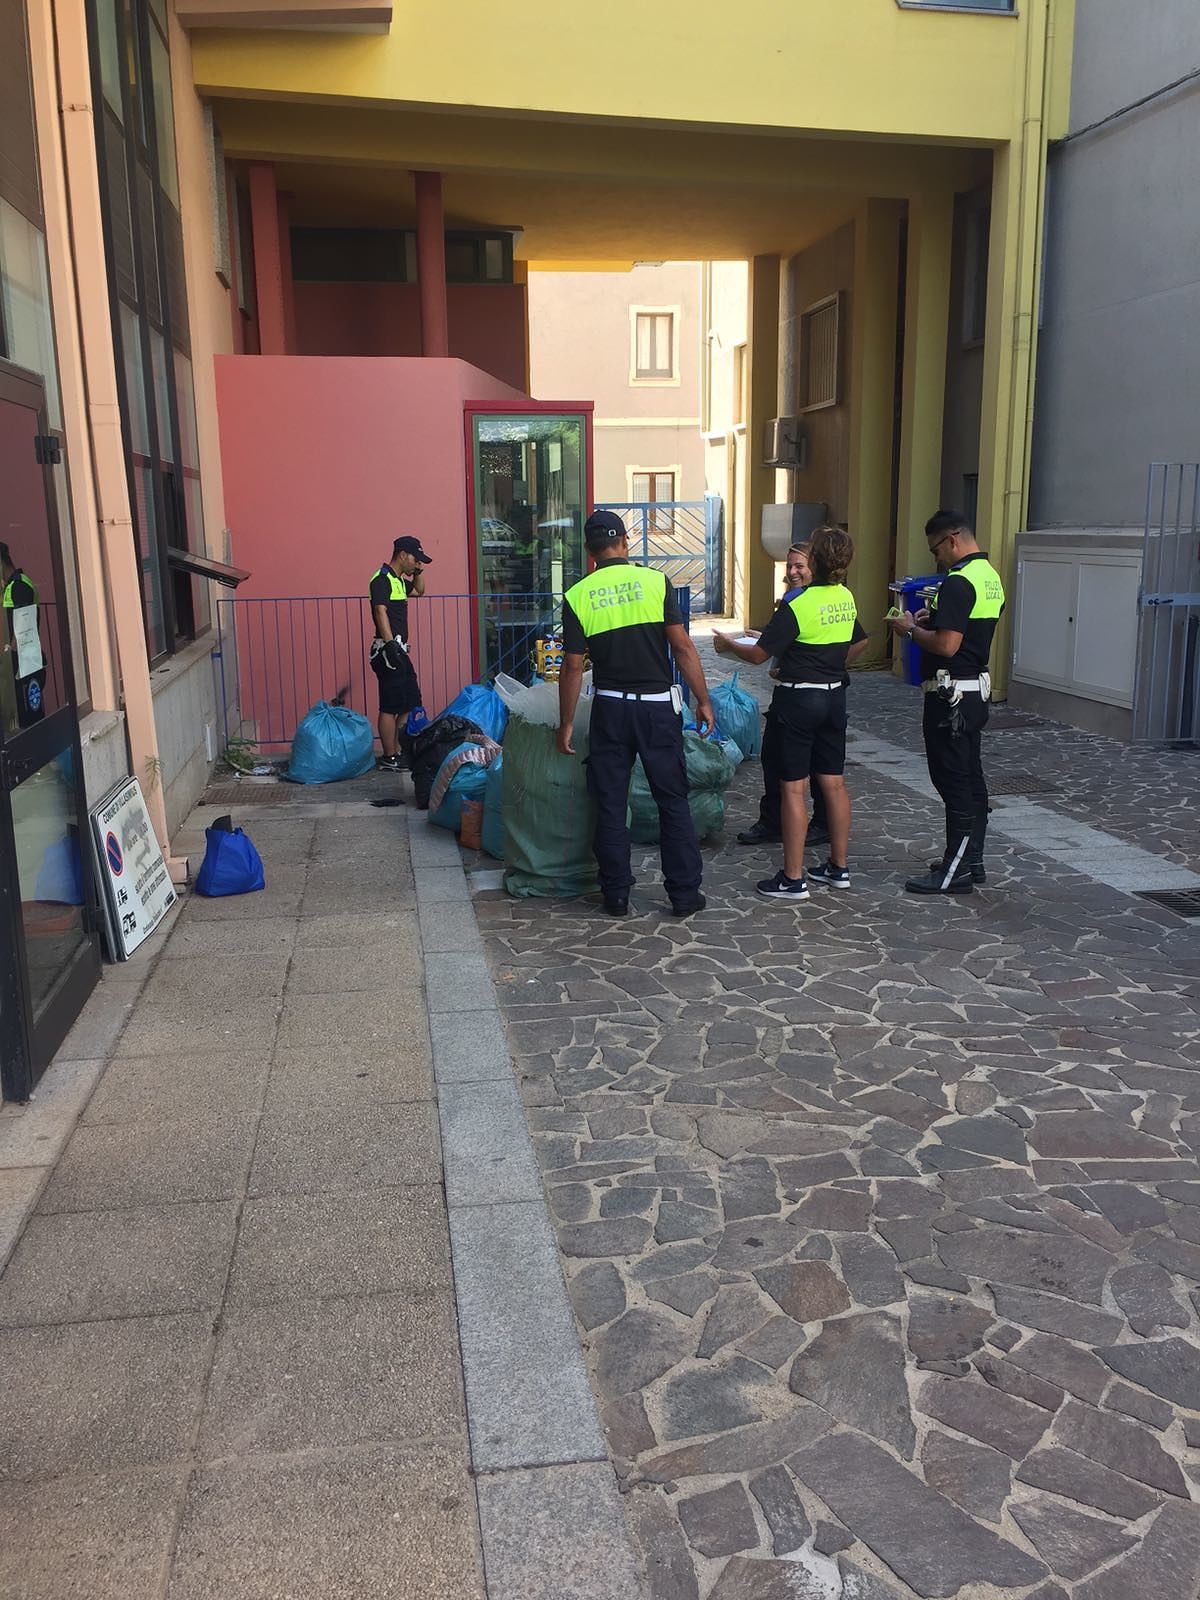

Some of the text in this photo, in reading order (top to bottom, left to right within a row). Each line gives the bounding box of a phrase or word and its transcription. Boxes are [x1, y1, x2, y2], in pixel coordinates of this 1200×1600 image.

[589, 581, 642, 599] POLIZIA
[591, 591, 644, 611] LOCALE
[820, 602, 855, 615] POLIZIA
[820, 612, 857, 625] LOCALE
